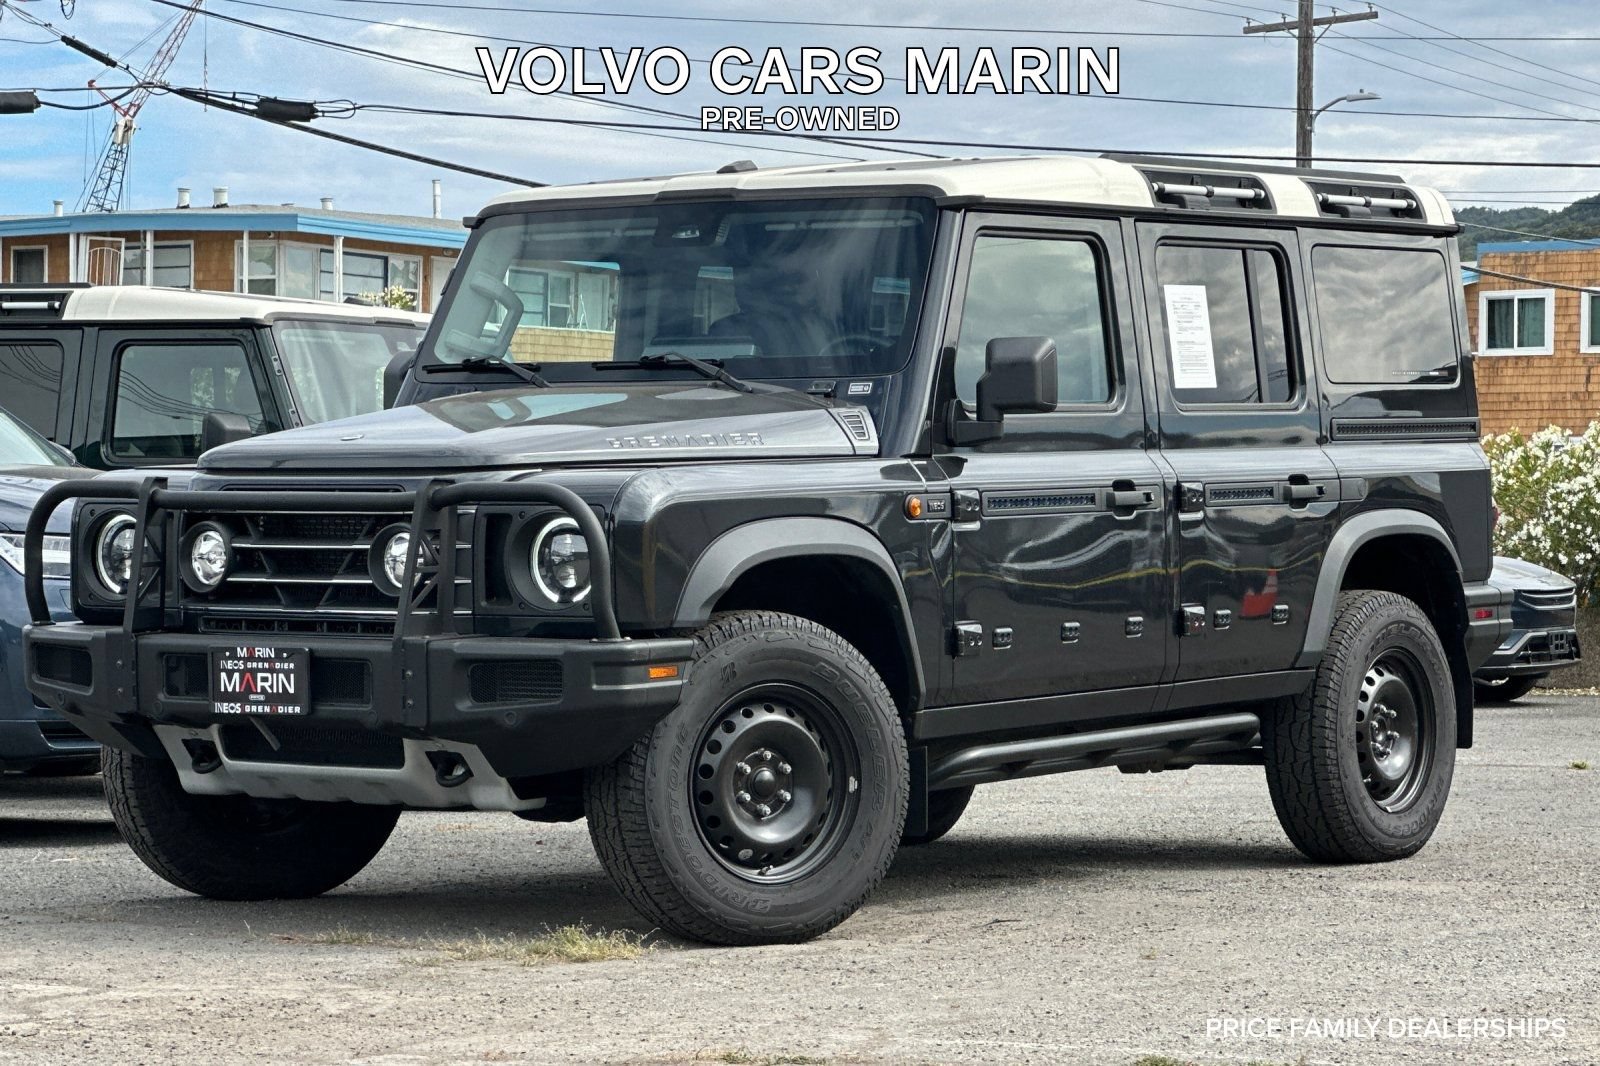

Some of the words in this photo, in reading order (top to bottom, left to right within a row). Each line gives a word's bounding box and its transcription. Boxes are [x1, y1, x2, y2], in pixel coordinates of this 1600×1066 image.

[605, 433, 765, 448] GRENADIER
[237, 647, 275, 658] MARIN
[220, 660, 244, 670] INEOS
[246, 662, 295, 670] GRENADIER
[220, 672, 295, 694] MARIN
[214, 702, 242, 714] INEOS
[244, 705, 301, 714] GRENADIER
[811, 661, 887, 812] DUELER
[666, 720, 772, 913] BRIDGESTONE
